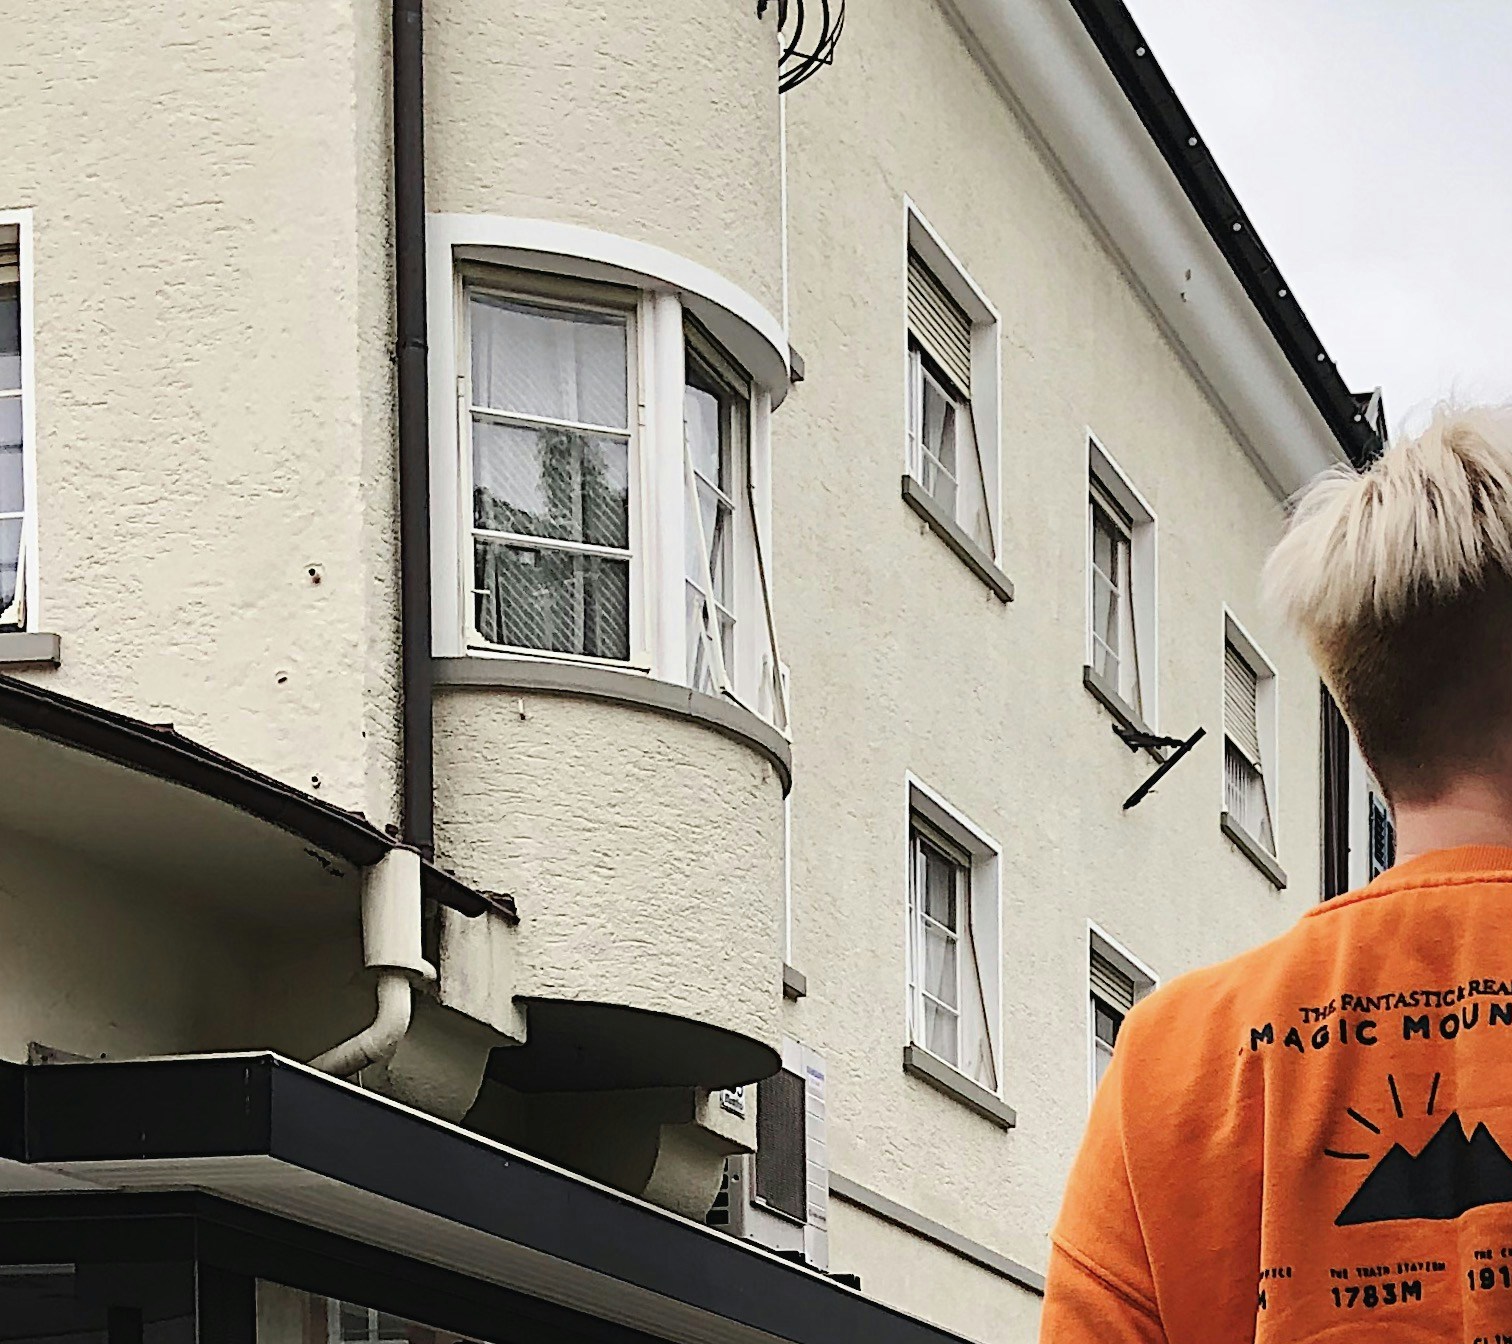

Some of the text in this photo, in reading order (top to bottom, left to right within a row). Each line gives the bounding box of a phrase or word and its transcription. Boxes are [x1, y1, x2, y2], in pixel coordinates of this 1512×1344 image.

[1299, 999, 1336, 1023] THE
[1340, 989, 1455, 1013] FANTASTIC
[1250, 1018, 1378, 1054] MAGIC
[1331, 1279, 1422, 1309] 1783M
